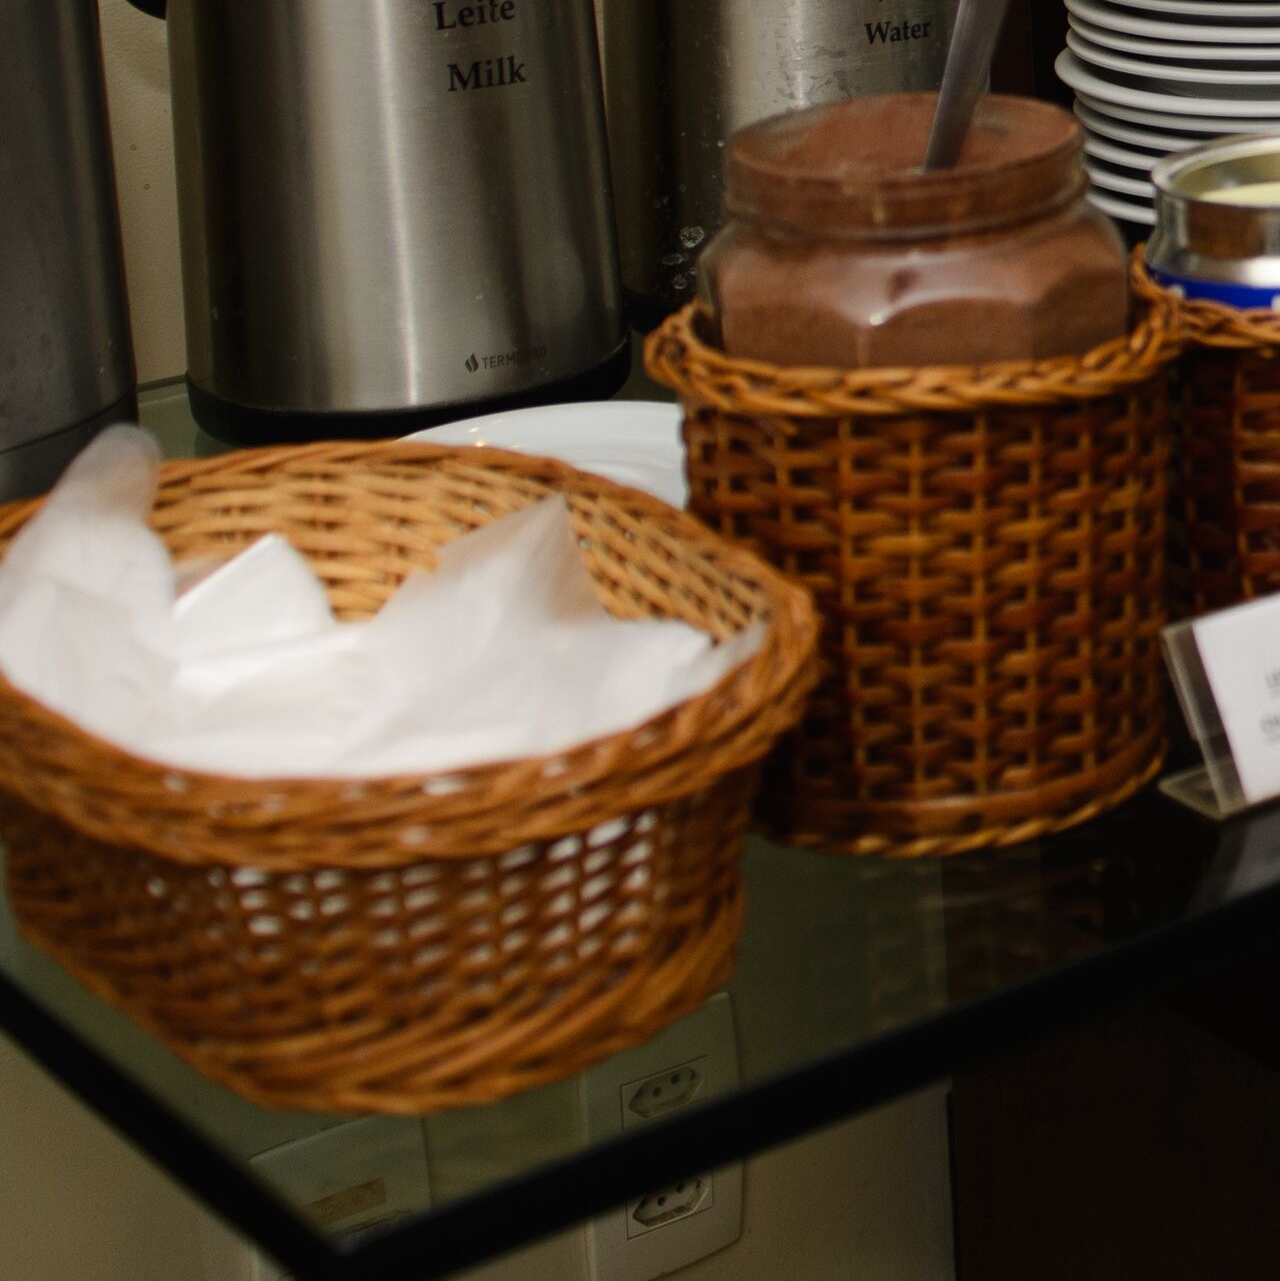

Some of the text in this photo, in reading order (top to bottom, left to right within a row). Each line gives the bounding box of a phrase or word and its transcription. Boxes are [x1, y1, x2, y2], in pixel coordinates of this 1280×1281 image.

[864, 20, 931, 45] Water
[446, 55, 527, 92] Milk
[481, 344, 546, 370] TERMOPRO
